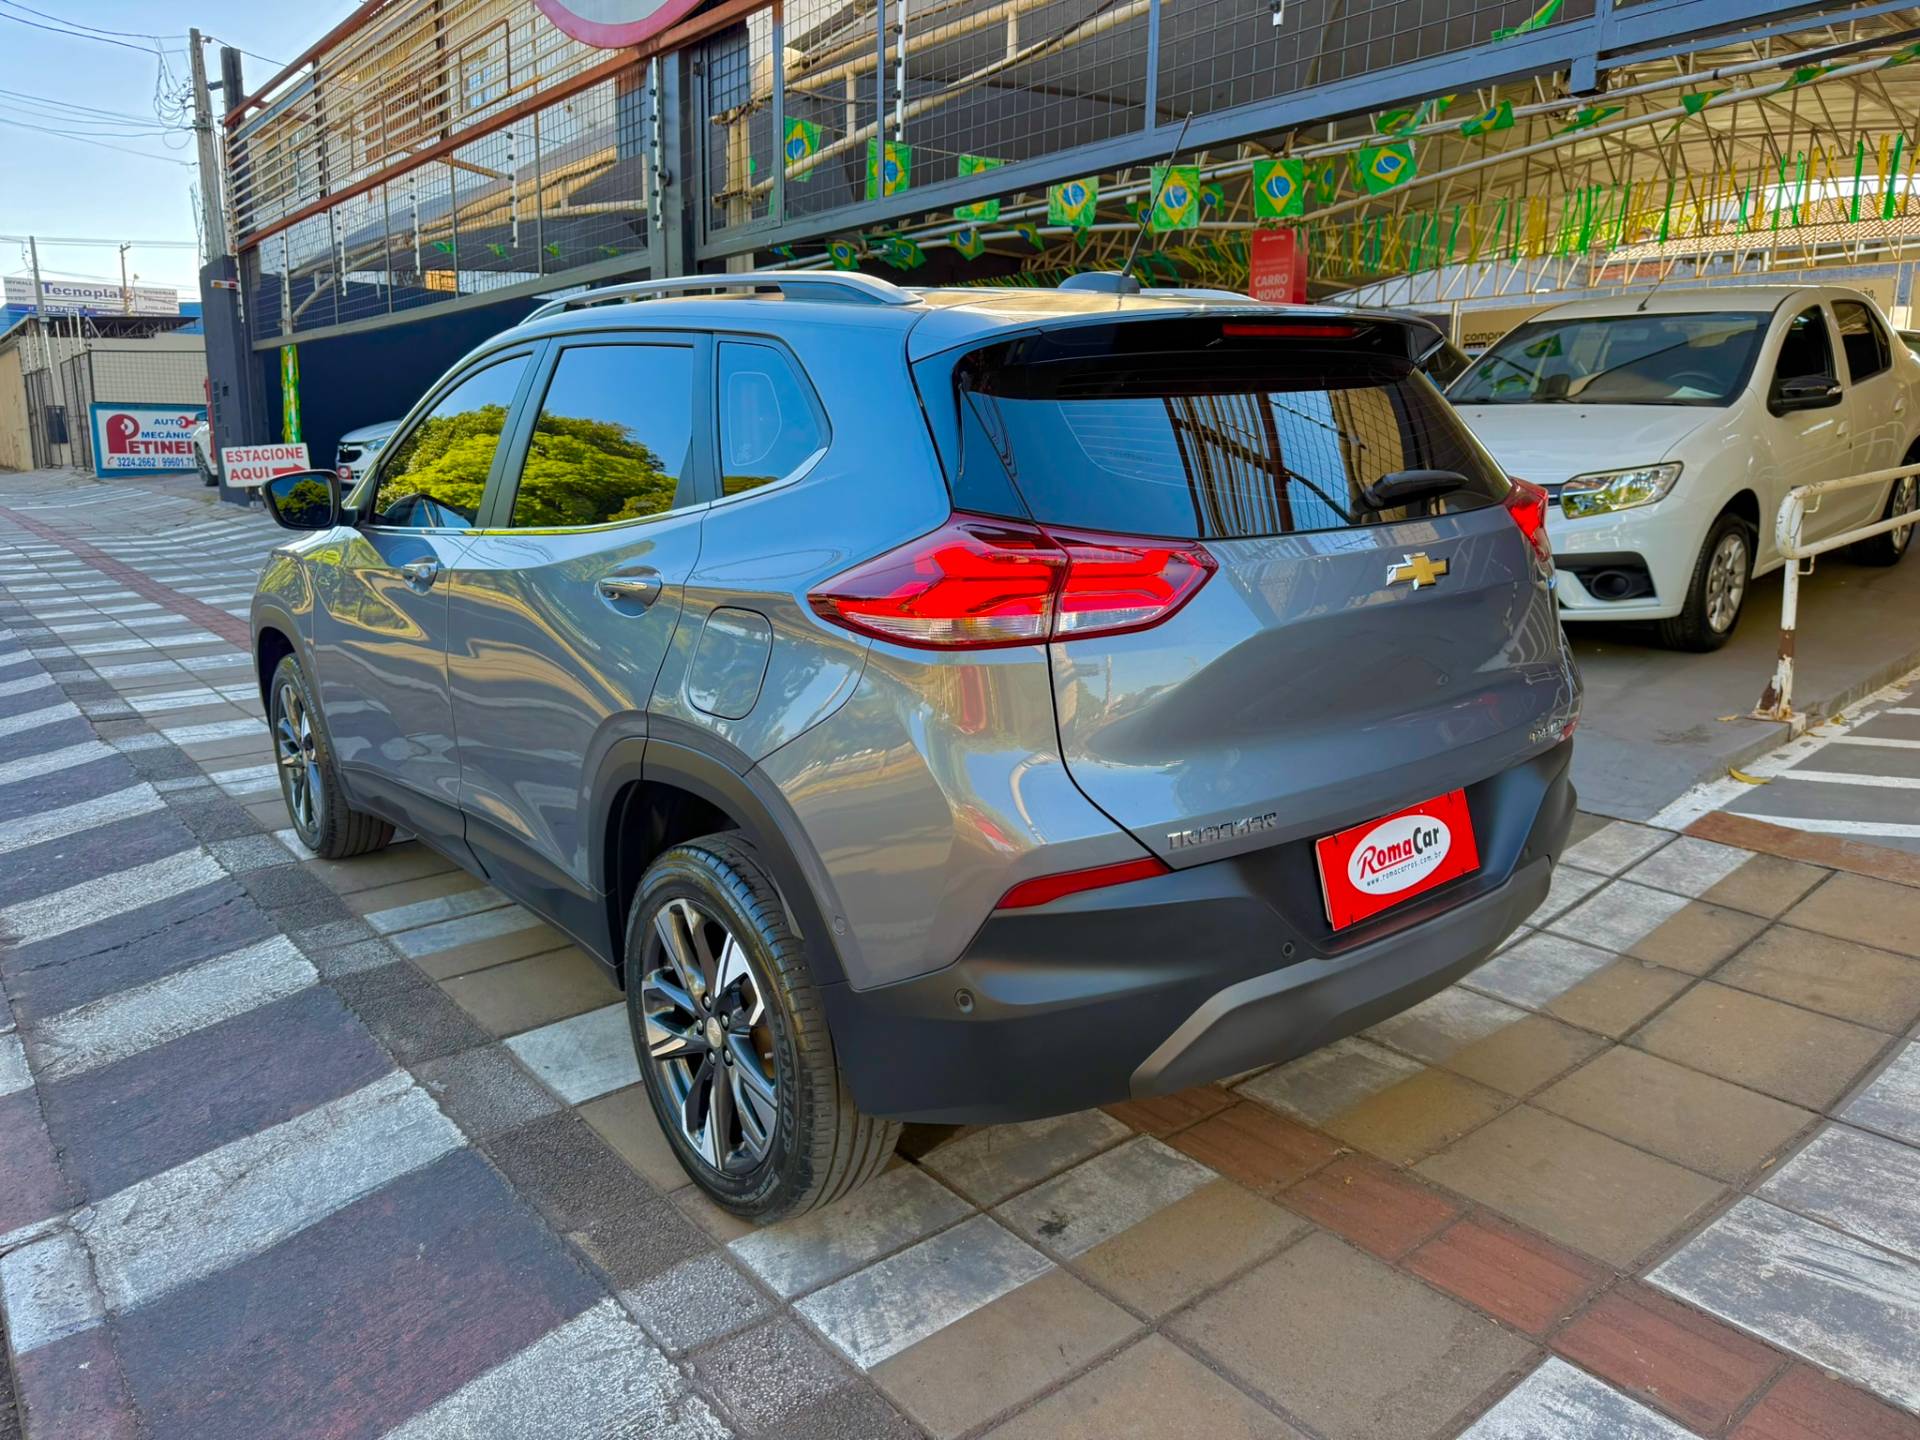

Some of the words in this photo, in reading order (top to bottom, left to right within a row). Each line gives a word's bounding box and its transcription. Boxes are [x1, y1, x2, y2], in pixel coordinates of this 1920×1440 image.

[1255, 273, 1288, 287] CARRO
[1256, 287, 1286, 300] NOVO
[154, 418, 183, 426] AUTO
[225, 446, 304, 463] ESTACIONE
[230, 466, 270, 481] AQUI
[1356, 826, 1440, 880] RomaCar
[1366, 849, 1442, 887] www.romacarros.com.br
